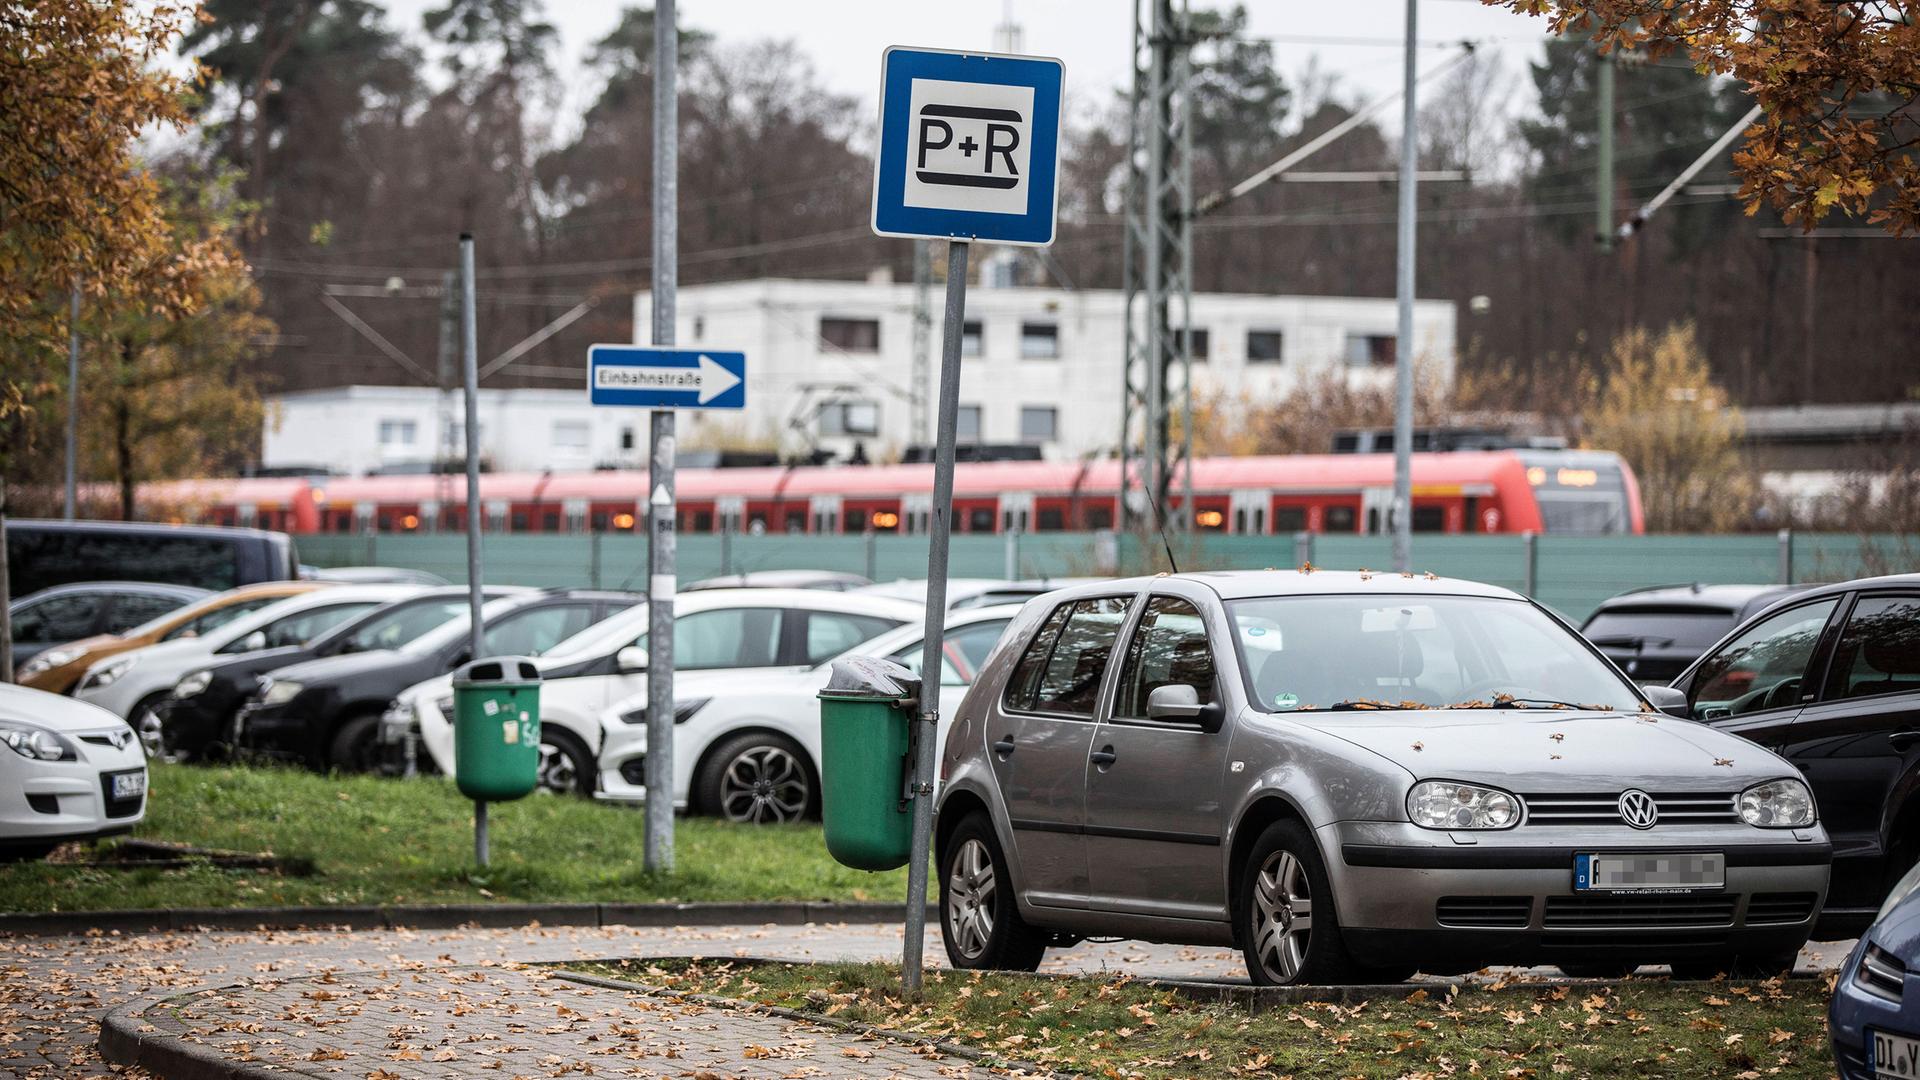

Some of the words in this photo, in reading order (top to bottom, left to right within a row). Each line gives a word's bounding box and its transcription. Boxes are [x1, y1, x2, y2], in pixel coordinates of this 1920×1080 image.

[917, 118, 1020, 176] P+R
[599, 369, 702, 385] Einbahnstraße
[1579, 874, 1586, 883] D
[1875, 1036, 1896, 1071] DI
